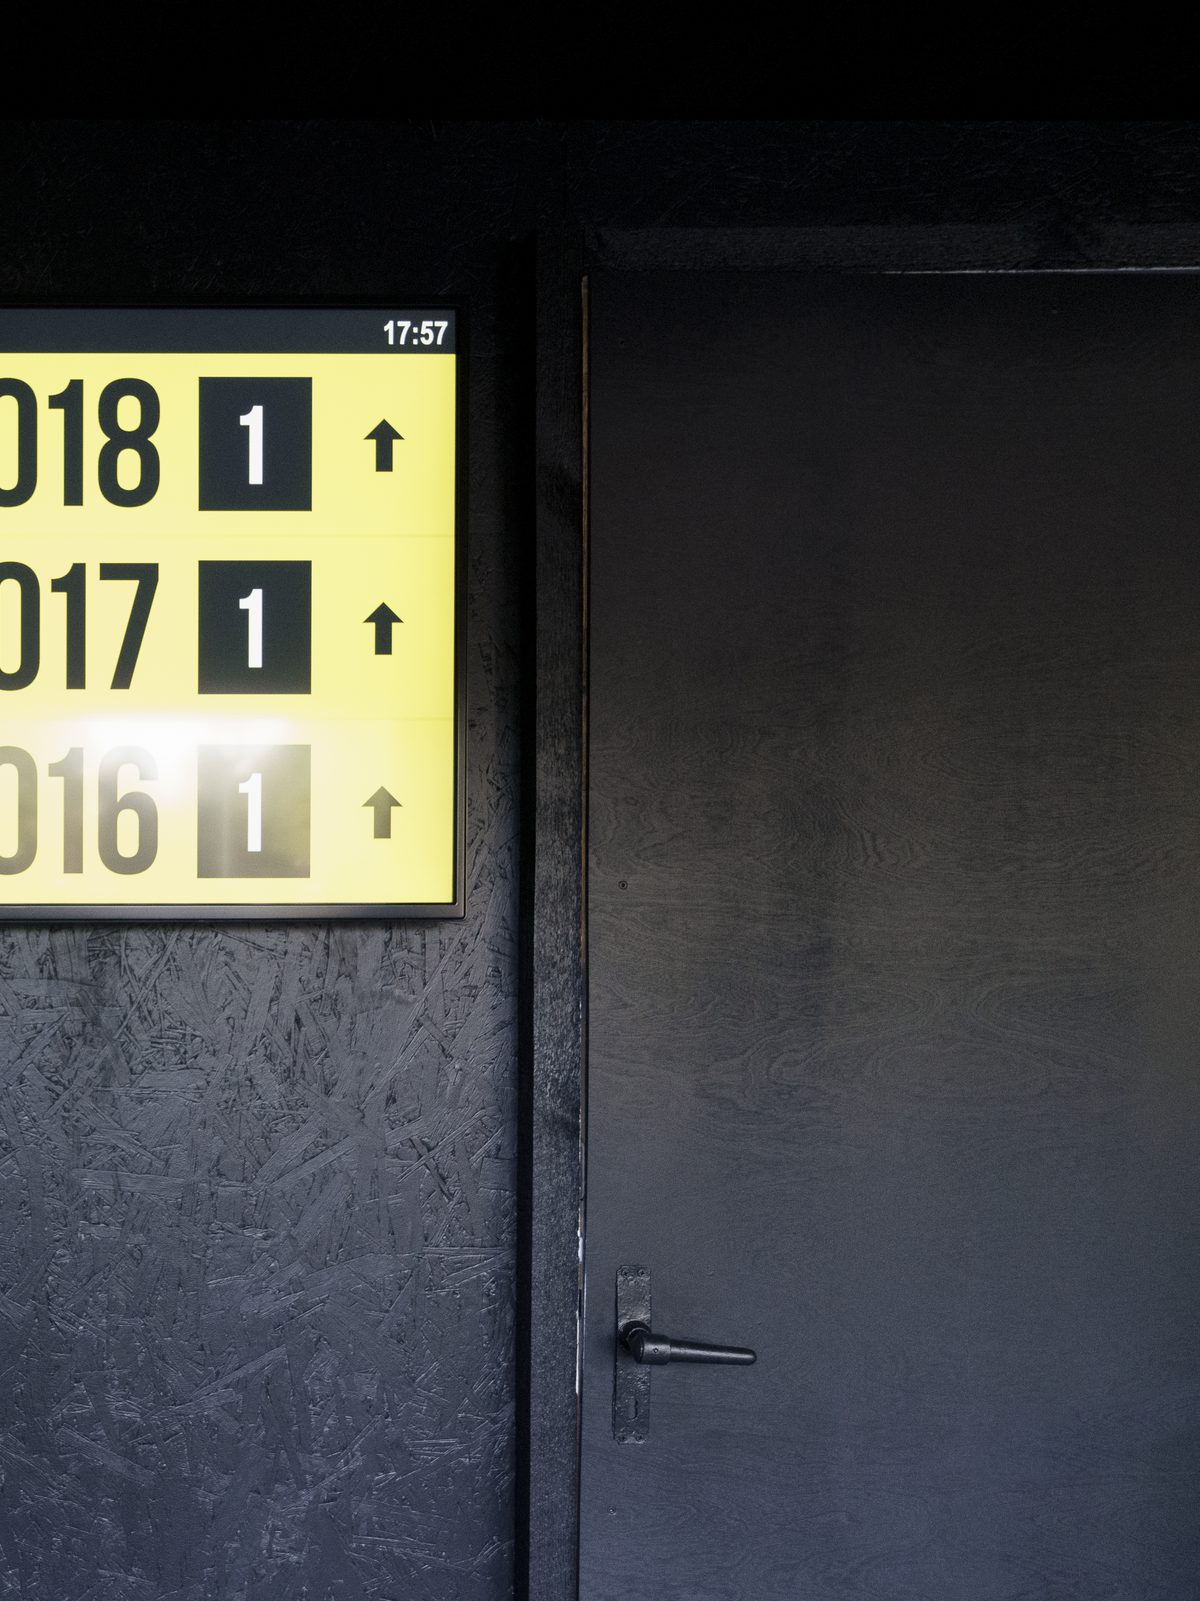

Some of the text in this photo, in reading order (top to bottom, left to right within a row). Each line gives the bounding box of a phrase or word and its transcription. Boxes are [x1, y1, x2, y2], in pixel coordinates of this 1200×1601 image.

[383, 319, 449, 346] 17:57
[239, 405, 263, 486] 1
[239, 588, 263, 669] 1
[238, 772, 263, 853] 1
